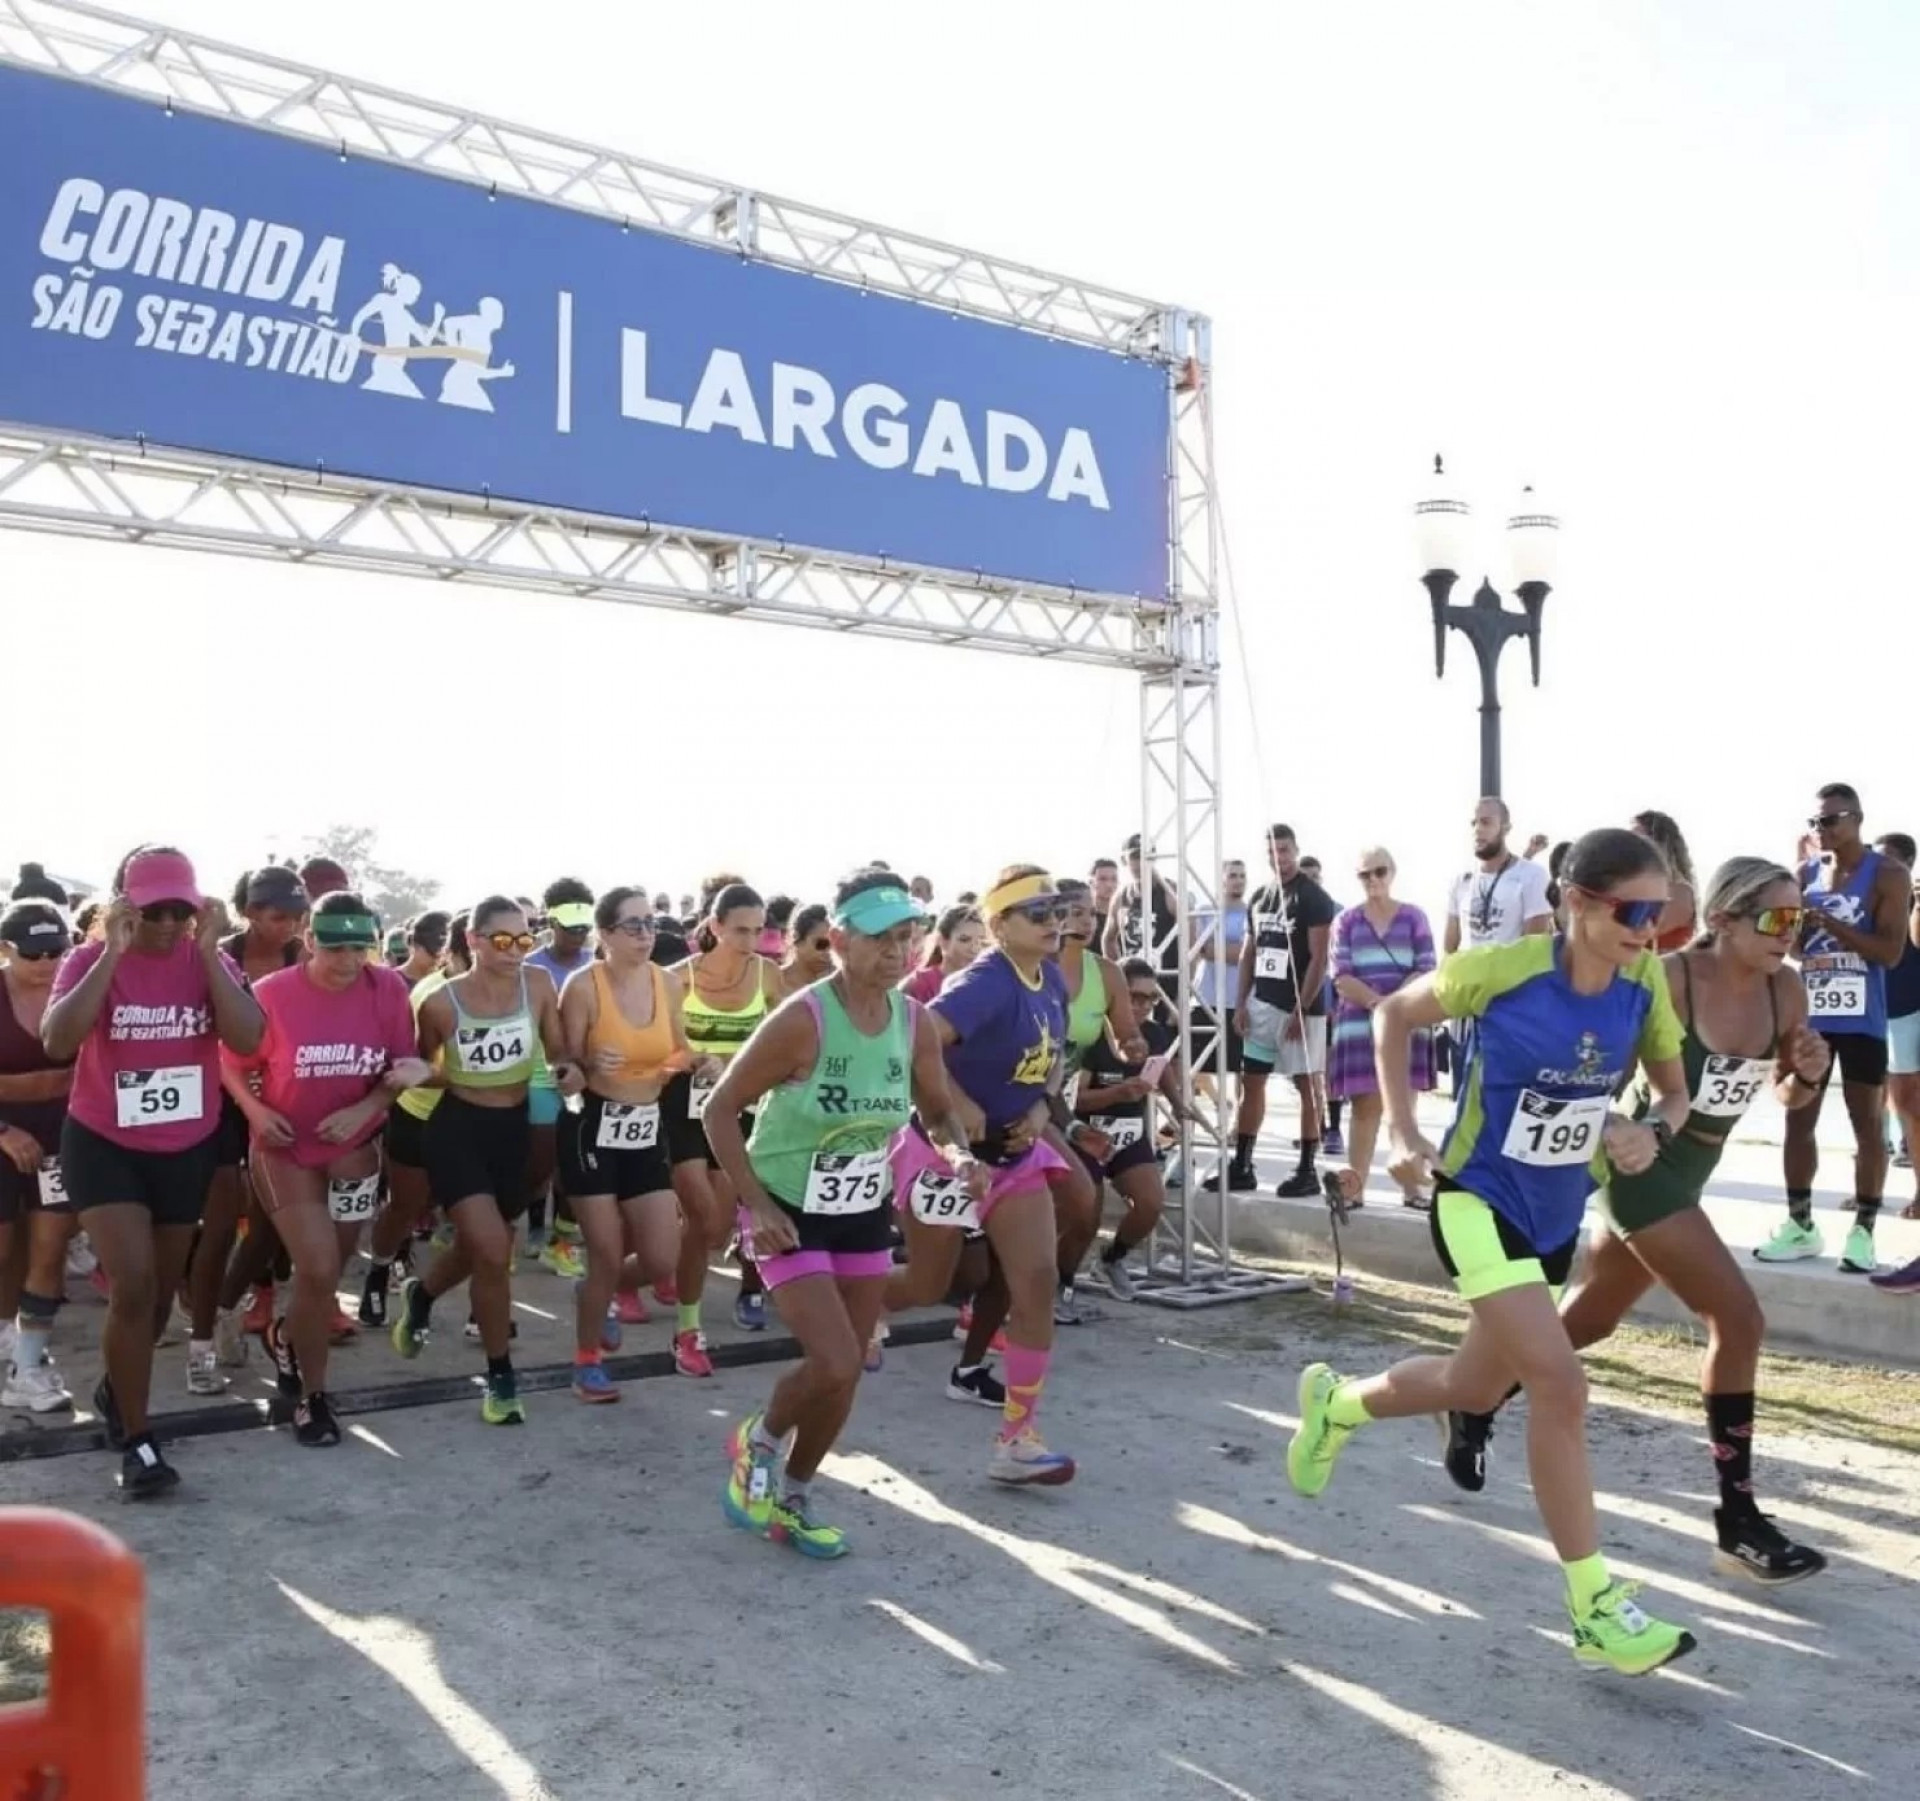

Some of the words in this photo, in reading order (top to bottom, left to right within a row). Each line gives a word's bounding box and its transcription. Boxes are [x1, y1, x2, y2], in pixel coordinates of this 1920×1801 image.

[39, 177, 346, 314] CORRIDA
[31, 266, 122, 340] SÃO
[135, 294, 359, 384] SEBASTIÃO
[620, 327, 1110, 511] LARGADA
[1813, 989, 1859, 1010] 593
[468, 1037, 524, 1066] 404
[140, 1087, 180, 1114] 59
[610, 1119, 654, 1141] 182
[1526, 1122, 1591, 1154] 199
[817, 1172, 881, 1202] 375
[922, 1193, 973, 1216] 197
